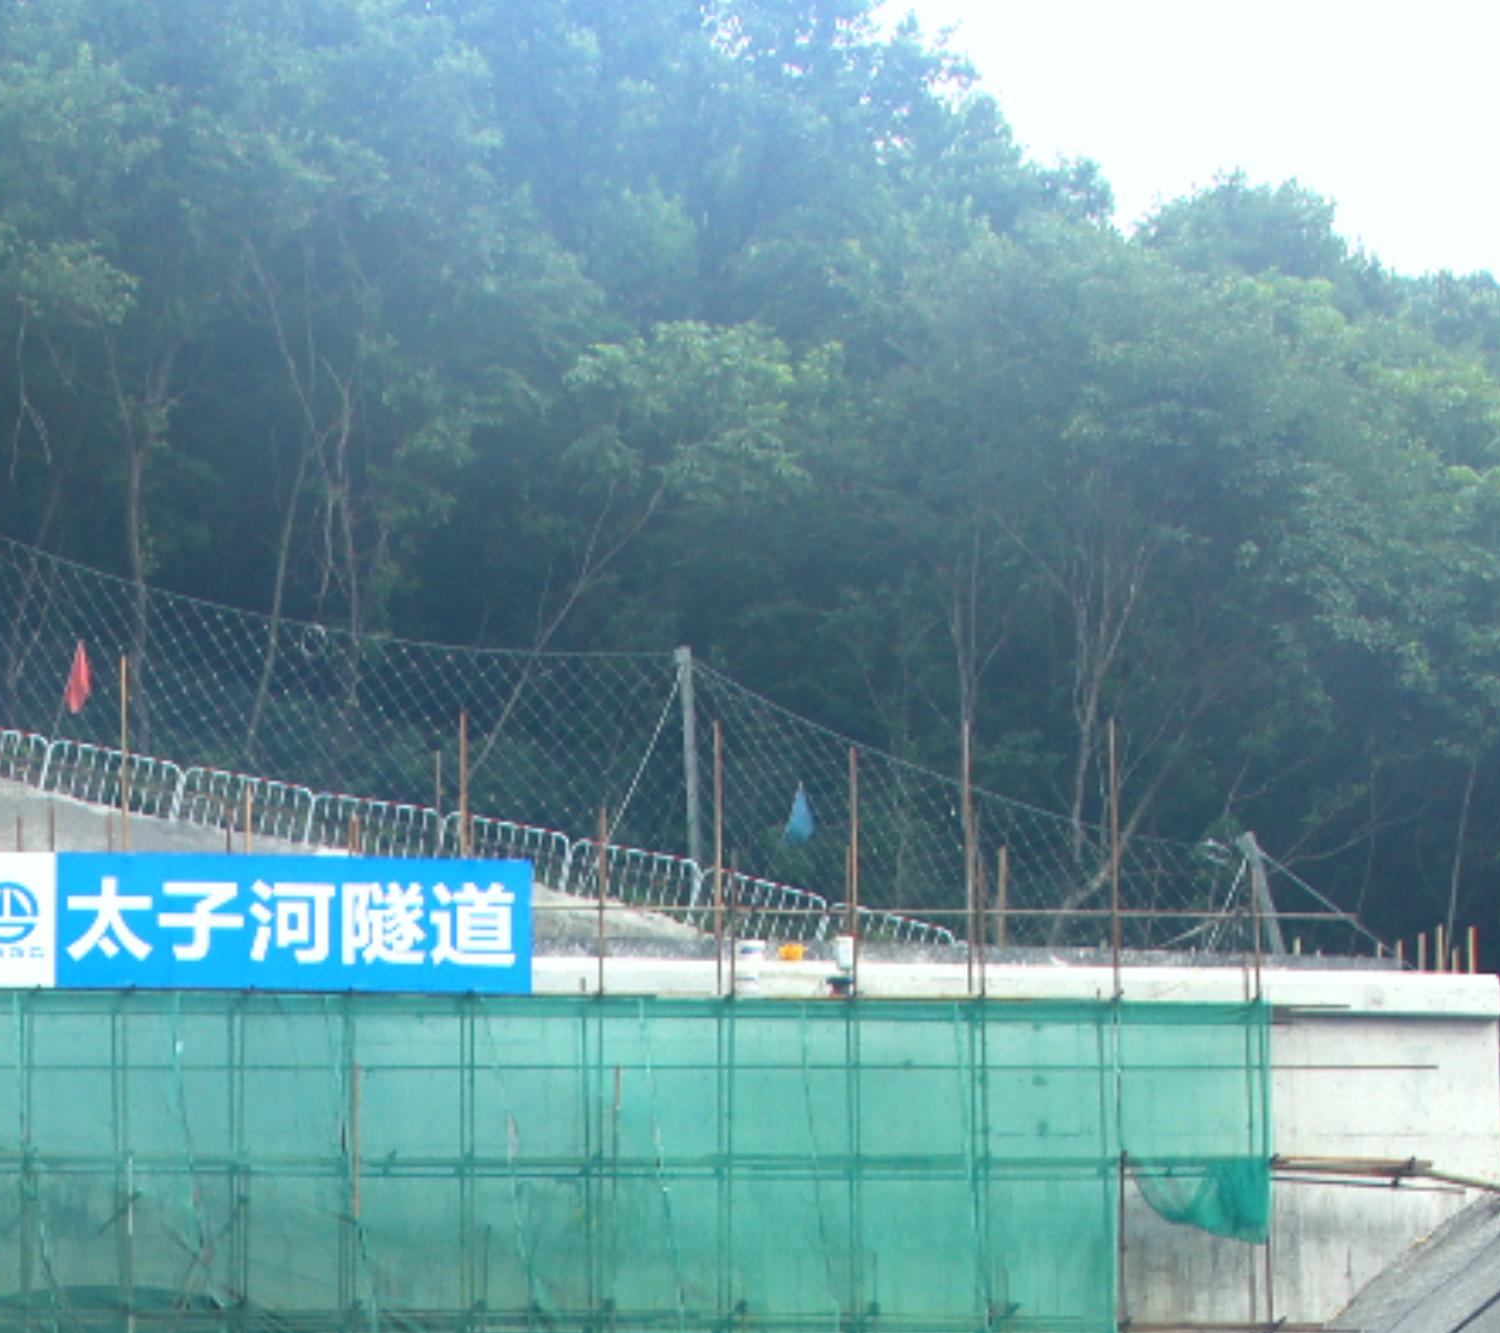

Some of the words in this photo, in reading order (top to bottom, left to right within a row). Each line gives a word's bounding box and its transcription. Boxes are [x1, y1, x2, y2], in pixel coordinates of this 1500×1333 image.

[66, 876, 516, 966] 太子河隧道
